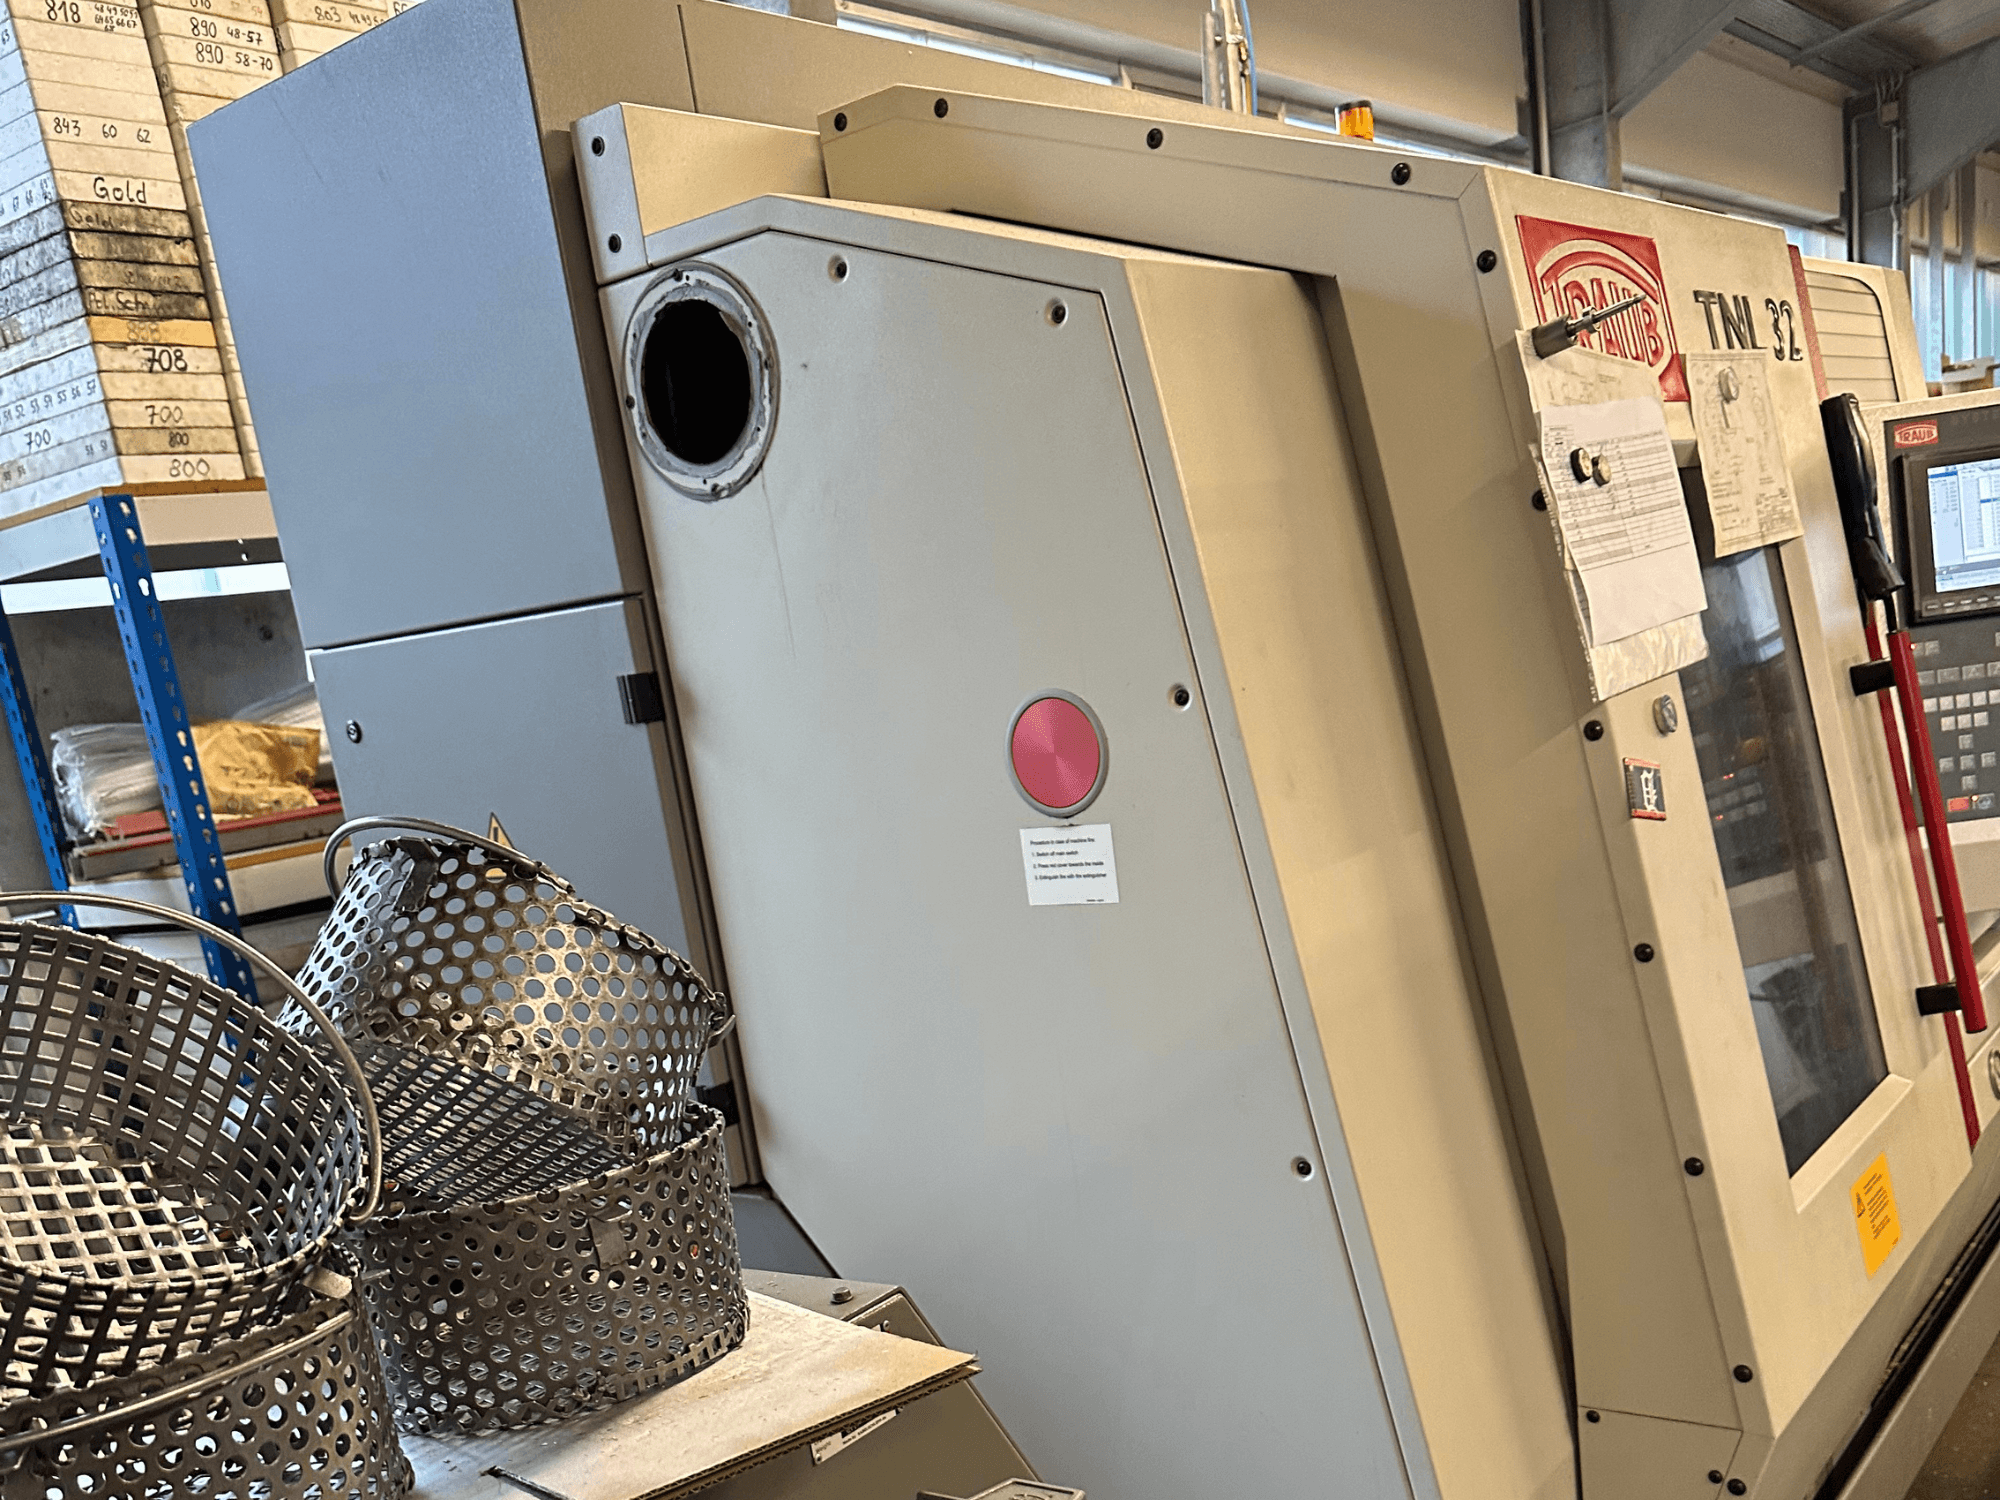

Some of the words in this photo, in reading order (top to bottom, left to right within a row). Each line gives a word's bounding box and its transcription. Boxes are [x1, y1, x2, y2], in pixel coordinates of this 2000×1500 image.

[45, 0, 81, 23] 818
[190, 16, 217, 38] 890
[226, 26, 263, 46] 48-57
[195, 42, 223, 64] 890
[235, 52, 273, 71] 58-70
[53, 116, 81, 137] 843
[102, 123, 117, 138] 60
[136, 128, 151, 144] 62
[93, 176, 147, 204] Gold
[1693, 290, 1768, 350] TNL
[1765, 298, 1804, 361] 32
[142, 347, 188, 373] 708
[145, 405, 183, 425] 700
[24, 428, 51, 455] 700
[1897, 426, 1935, 443] TRAUB
[169, 457, 210, 478] 800
